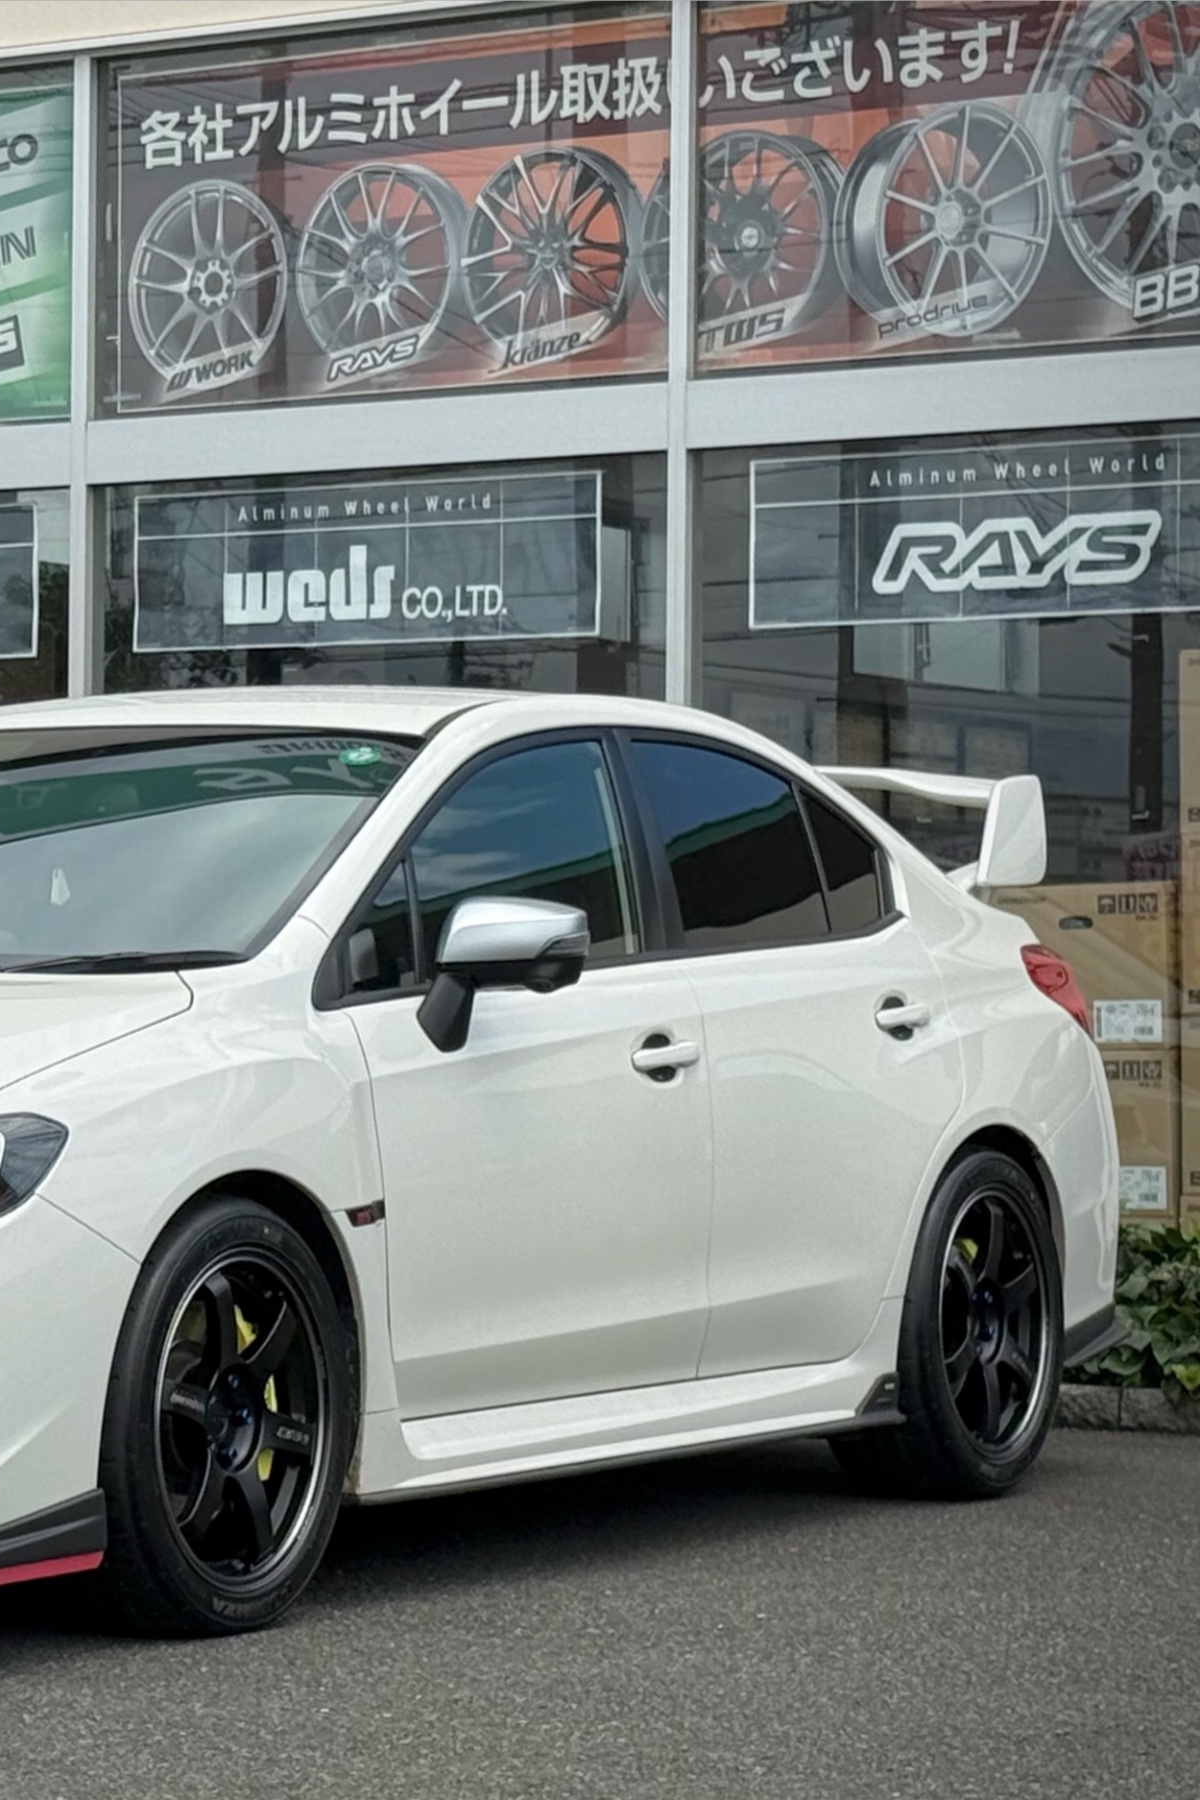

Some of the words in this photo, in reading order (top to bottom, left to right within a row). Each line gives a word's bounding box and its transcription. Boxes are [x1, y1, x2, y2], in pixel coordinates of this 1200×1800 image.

[697, 308, 786, 353] TWS
[877, 294, 988, 338] prodrive
[195, 349, 254, 384] WORK
[326, 333, 419, 382] RAYS
[869, 468, 977, 488] Alminum
[994, 458, 1071, 481] Wheel
[1089, 452, 1167, 474] World
[238, 504, 330, 523] Alminum
[344, 497, 410, 518] Wheel
[425, 492, 492, 512] World
[872, 509, 1162, 595] RAYS
